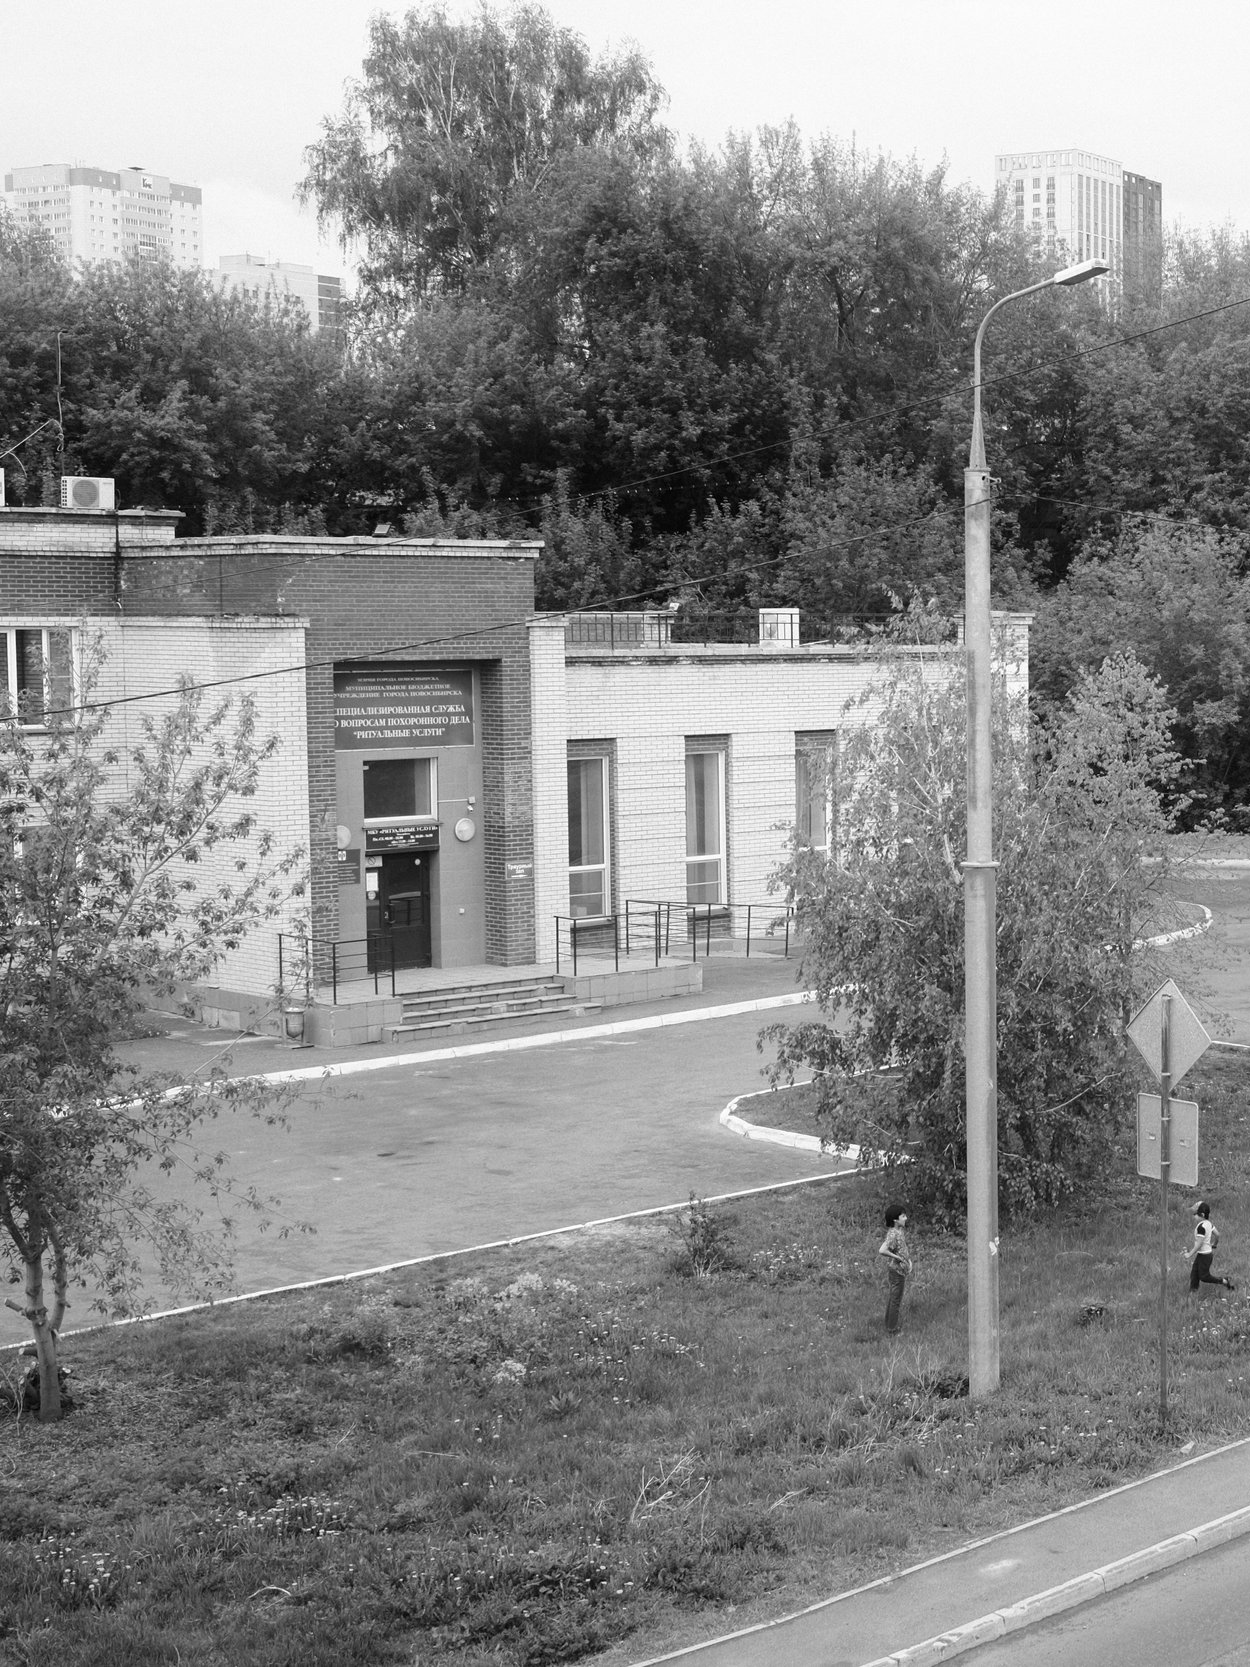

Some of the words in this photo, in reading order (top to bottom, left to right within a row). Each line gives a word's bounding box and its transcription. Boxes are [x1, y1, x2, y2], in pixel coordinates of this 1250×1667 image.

[334, 706, 430, 716] ПЕЦИАЛИЗИРОВАННАЯ
[432, 704, 466, 713] СЛУЖБА
[340, 718, 386, 728] ВОПРОСАМ
[388, 716, 449, 726] ПОХОРОННОГО
[450, 716, 470, 726] ДЕЛА
